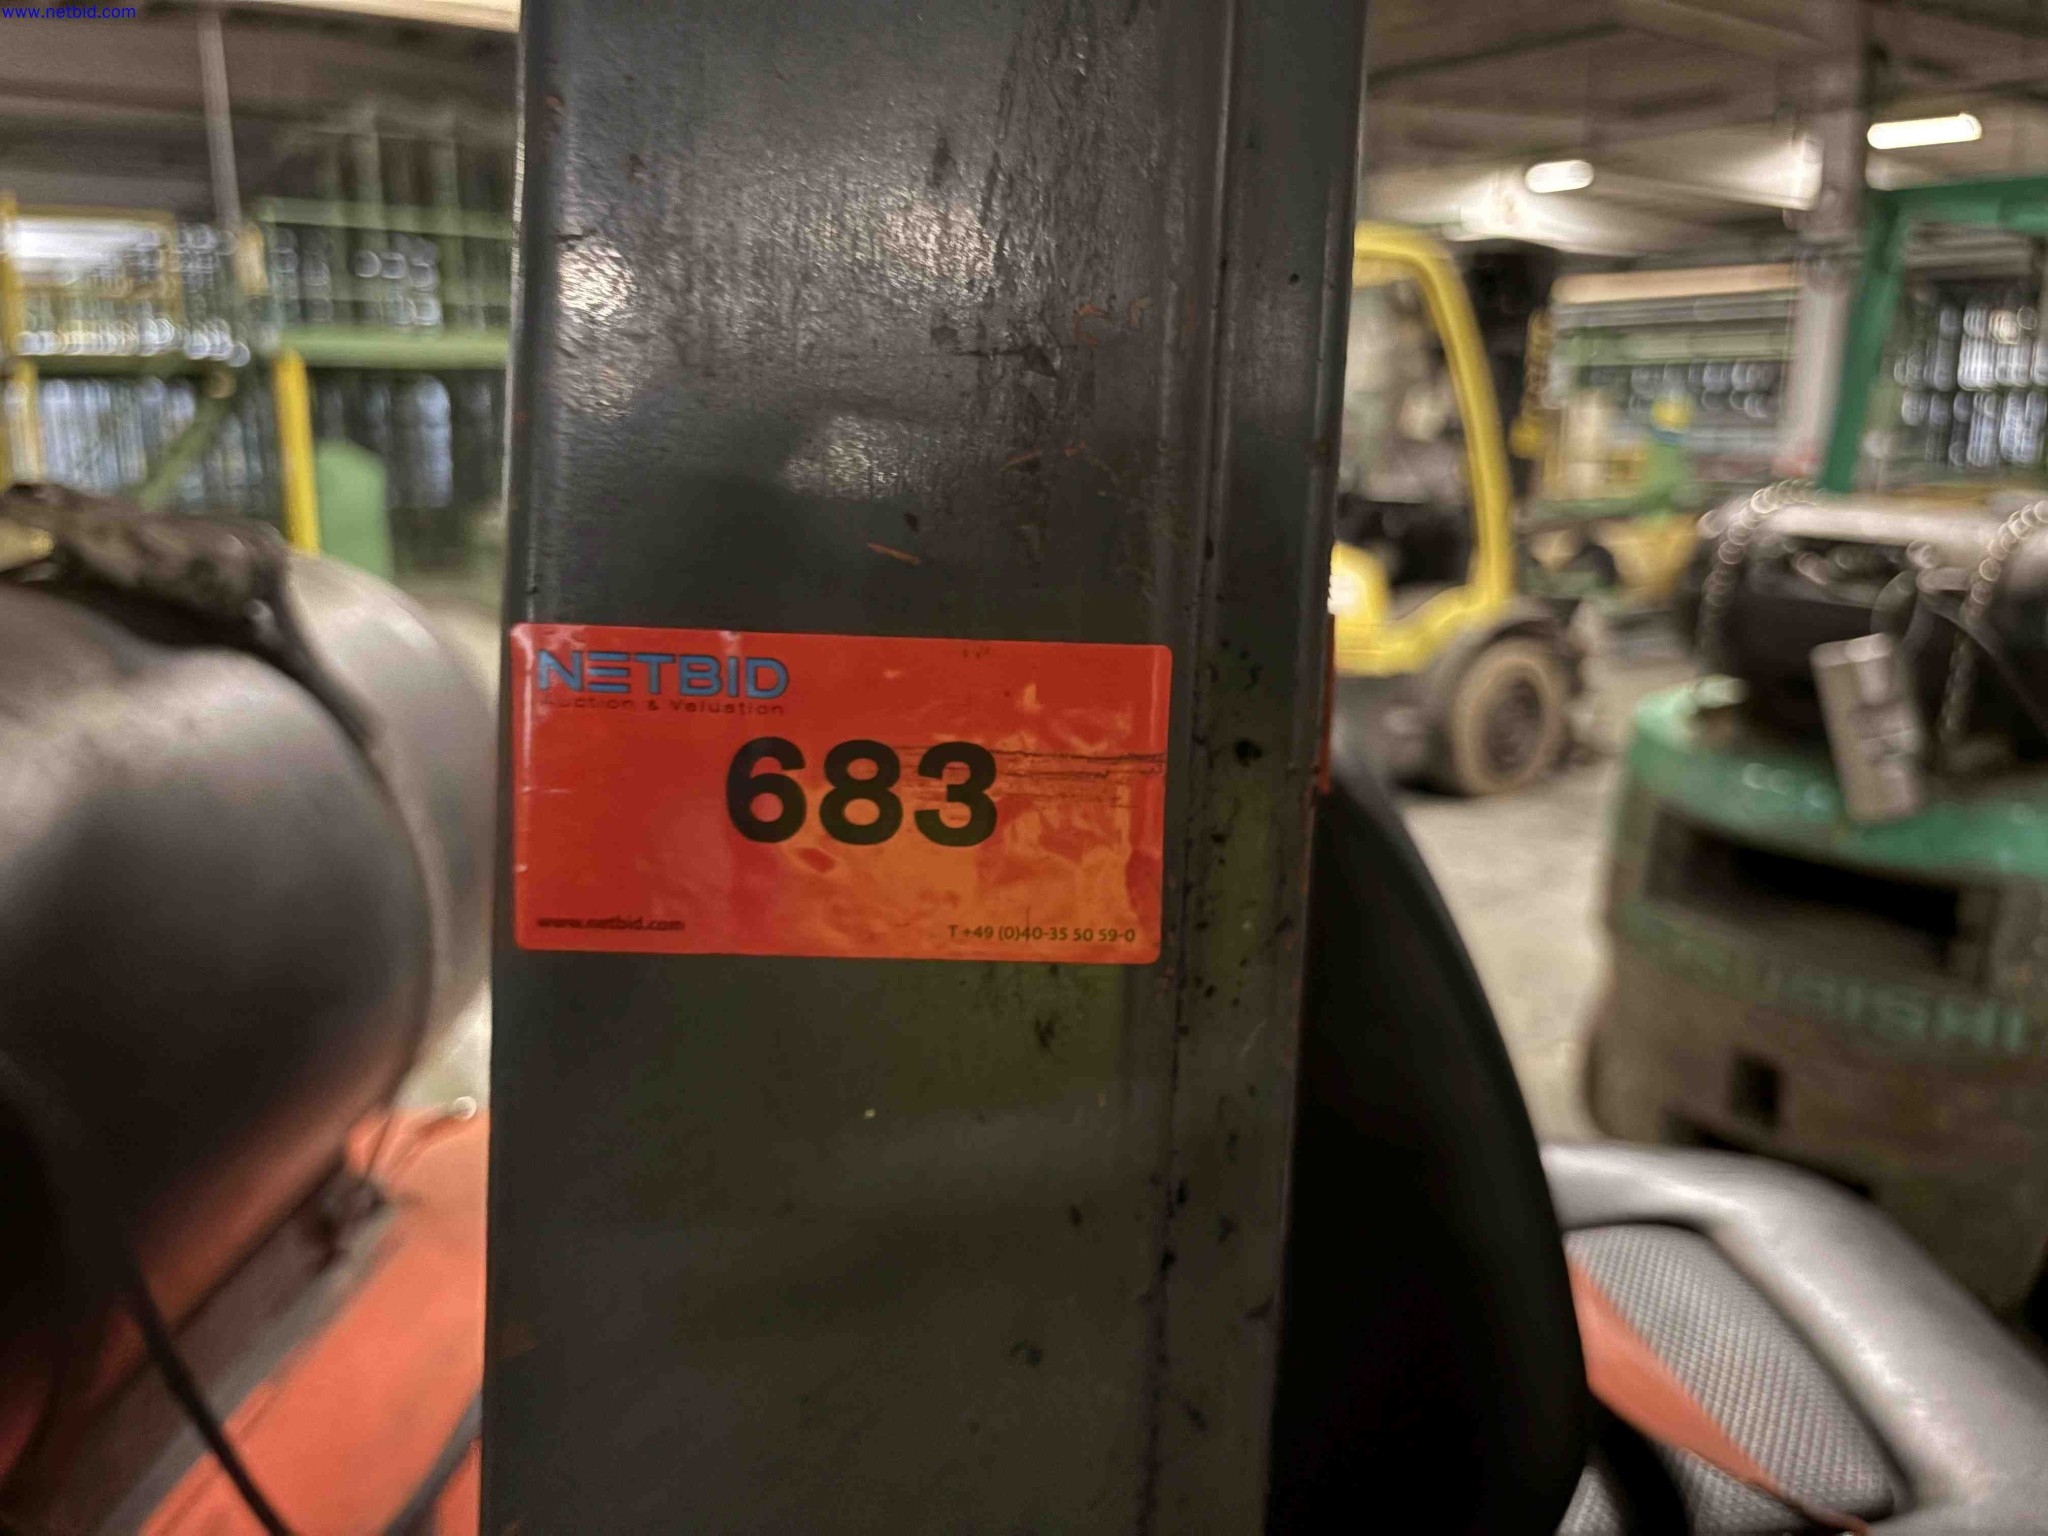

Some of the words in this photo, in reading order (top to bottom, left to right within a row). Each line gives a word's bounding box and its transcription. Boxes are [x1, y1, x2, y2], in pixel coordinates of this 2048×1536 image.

[537, 650, 789, 699] NETBID
[646, 699, 659, 711] &
[670, 700, 784, 716] Valuation
[726, 736, 997, 847] 683
[948, 924, 959, 938] T
[962, 925, 994, 939] +49
[998, 926, 1068, 941] (0)40-35
[1073, 927, 1094, 942] 50
[1099, 928, 1136, 942] 59-0
